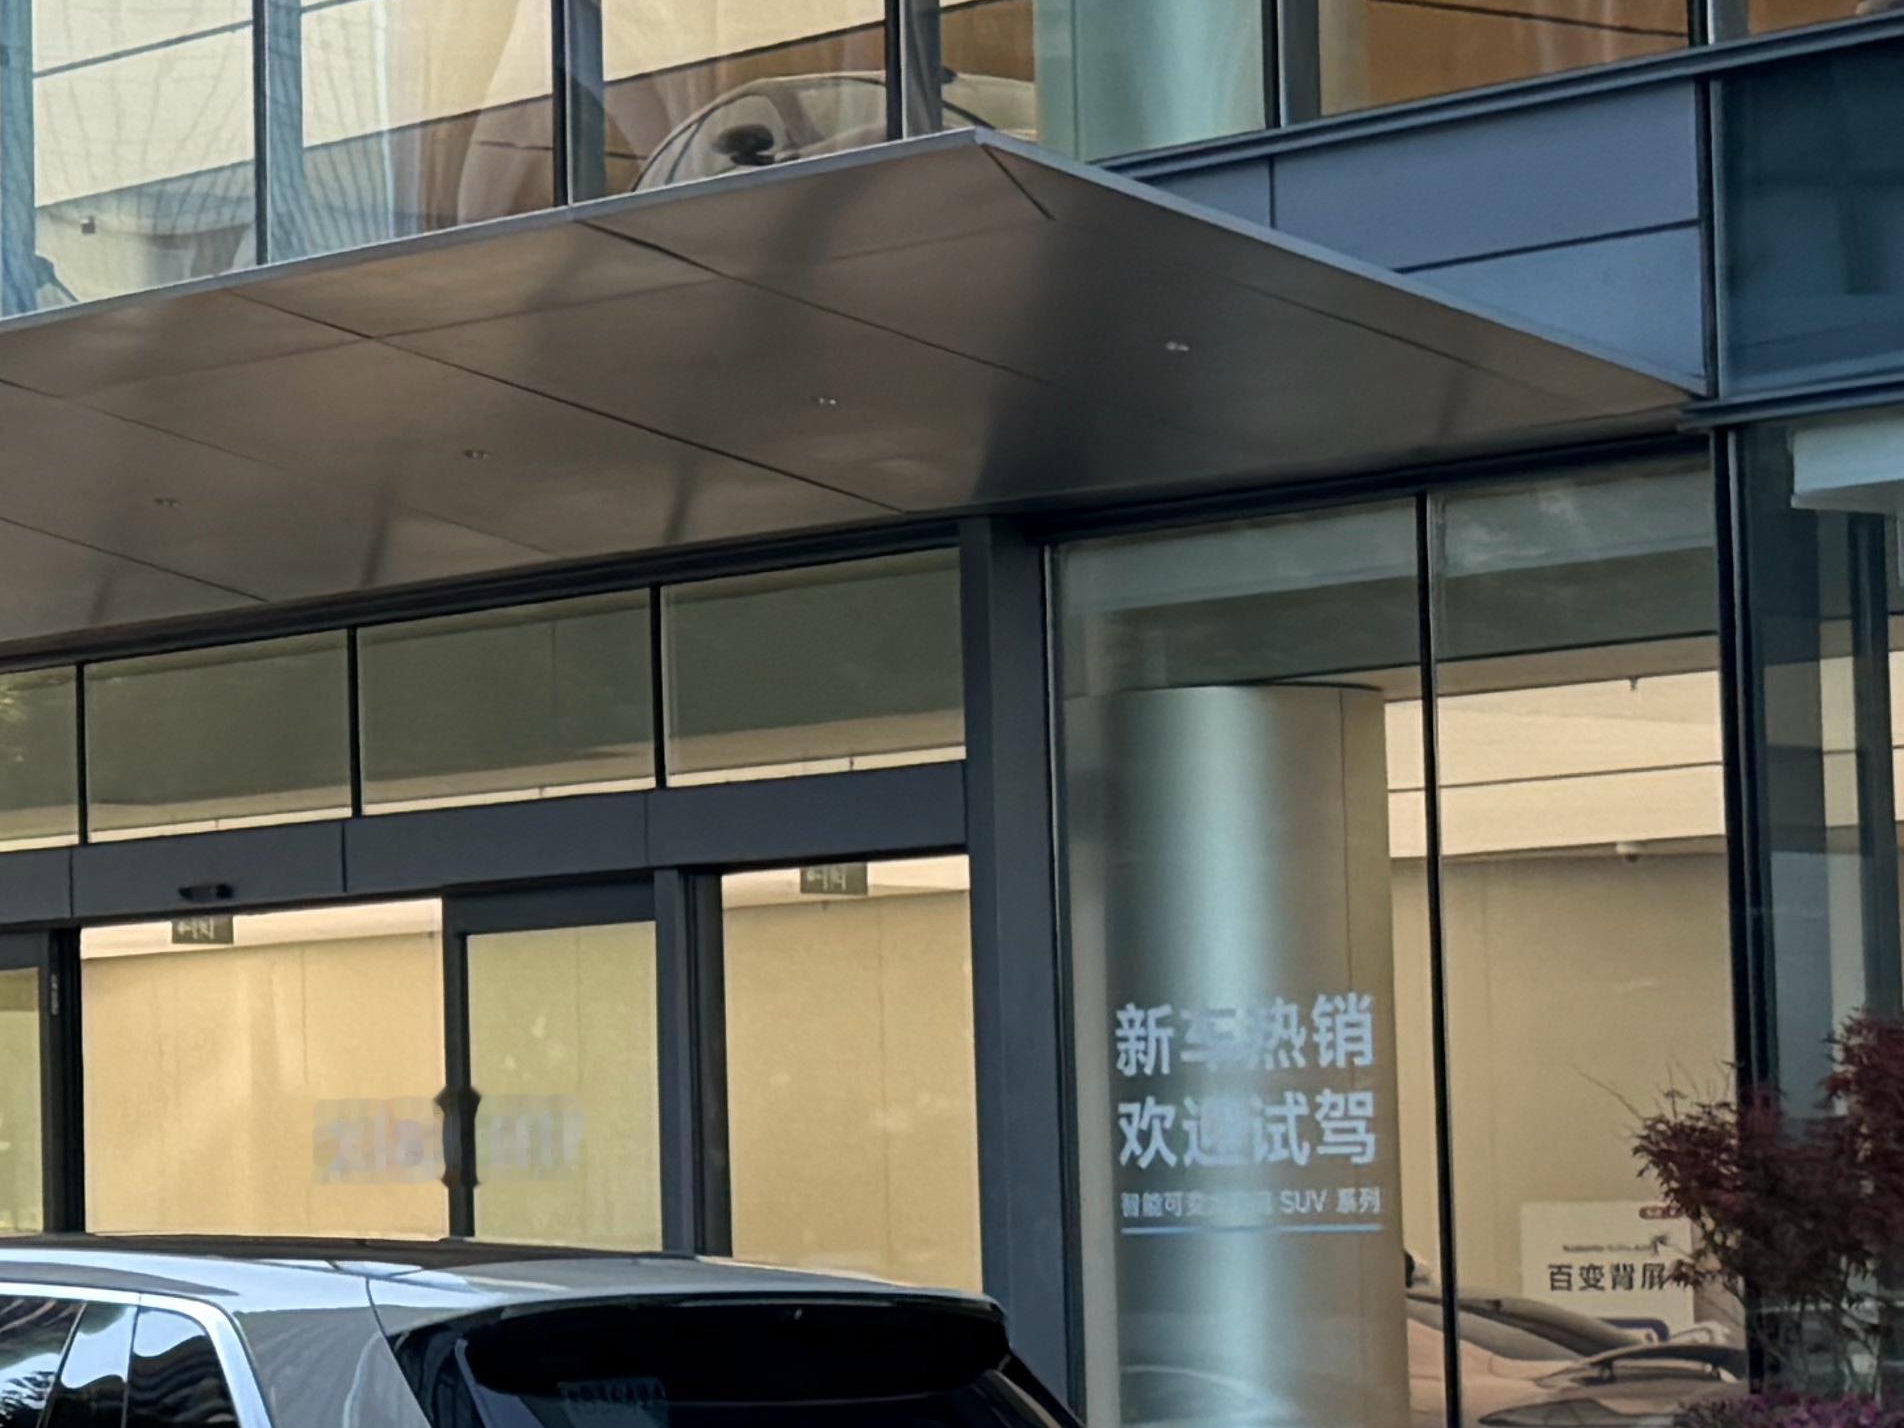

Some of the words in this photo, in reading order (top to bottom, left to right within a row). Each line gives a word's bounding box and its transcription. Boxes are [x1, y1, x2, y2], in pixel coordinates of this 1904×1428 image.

[1115, 992, 1374, 1077] 新车热销
[1118, 1088, 1377, 1169] 欢迎试驾
[1280, 1189, 1328, 1214] SUV
